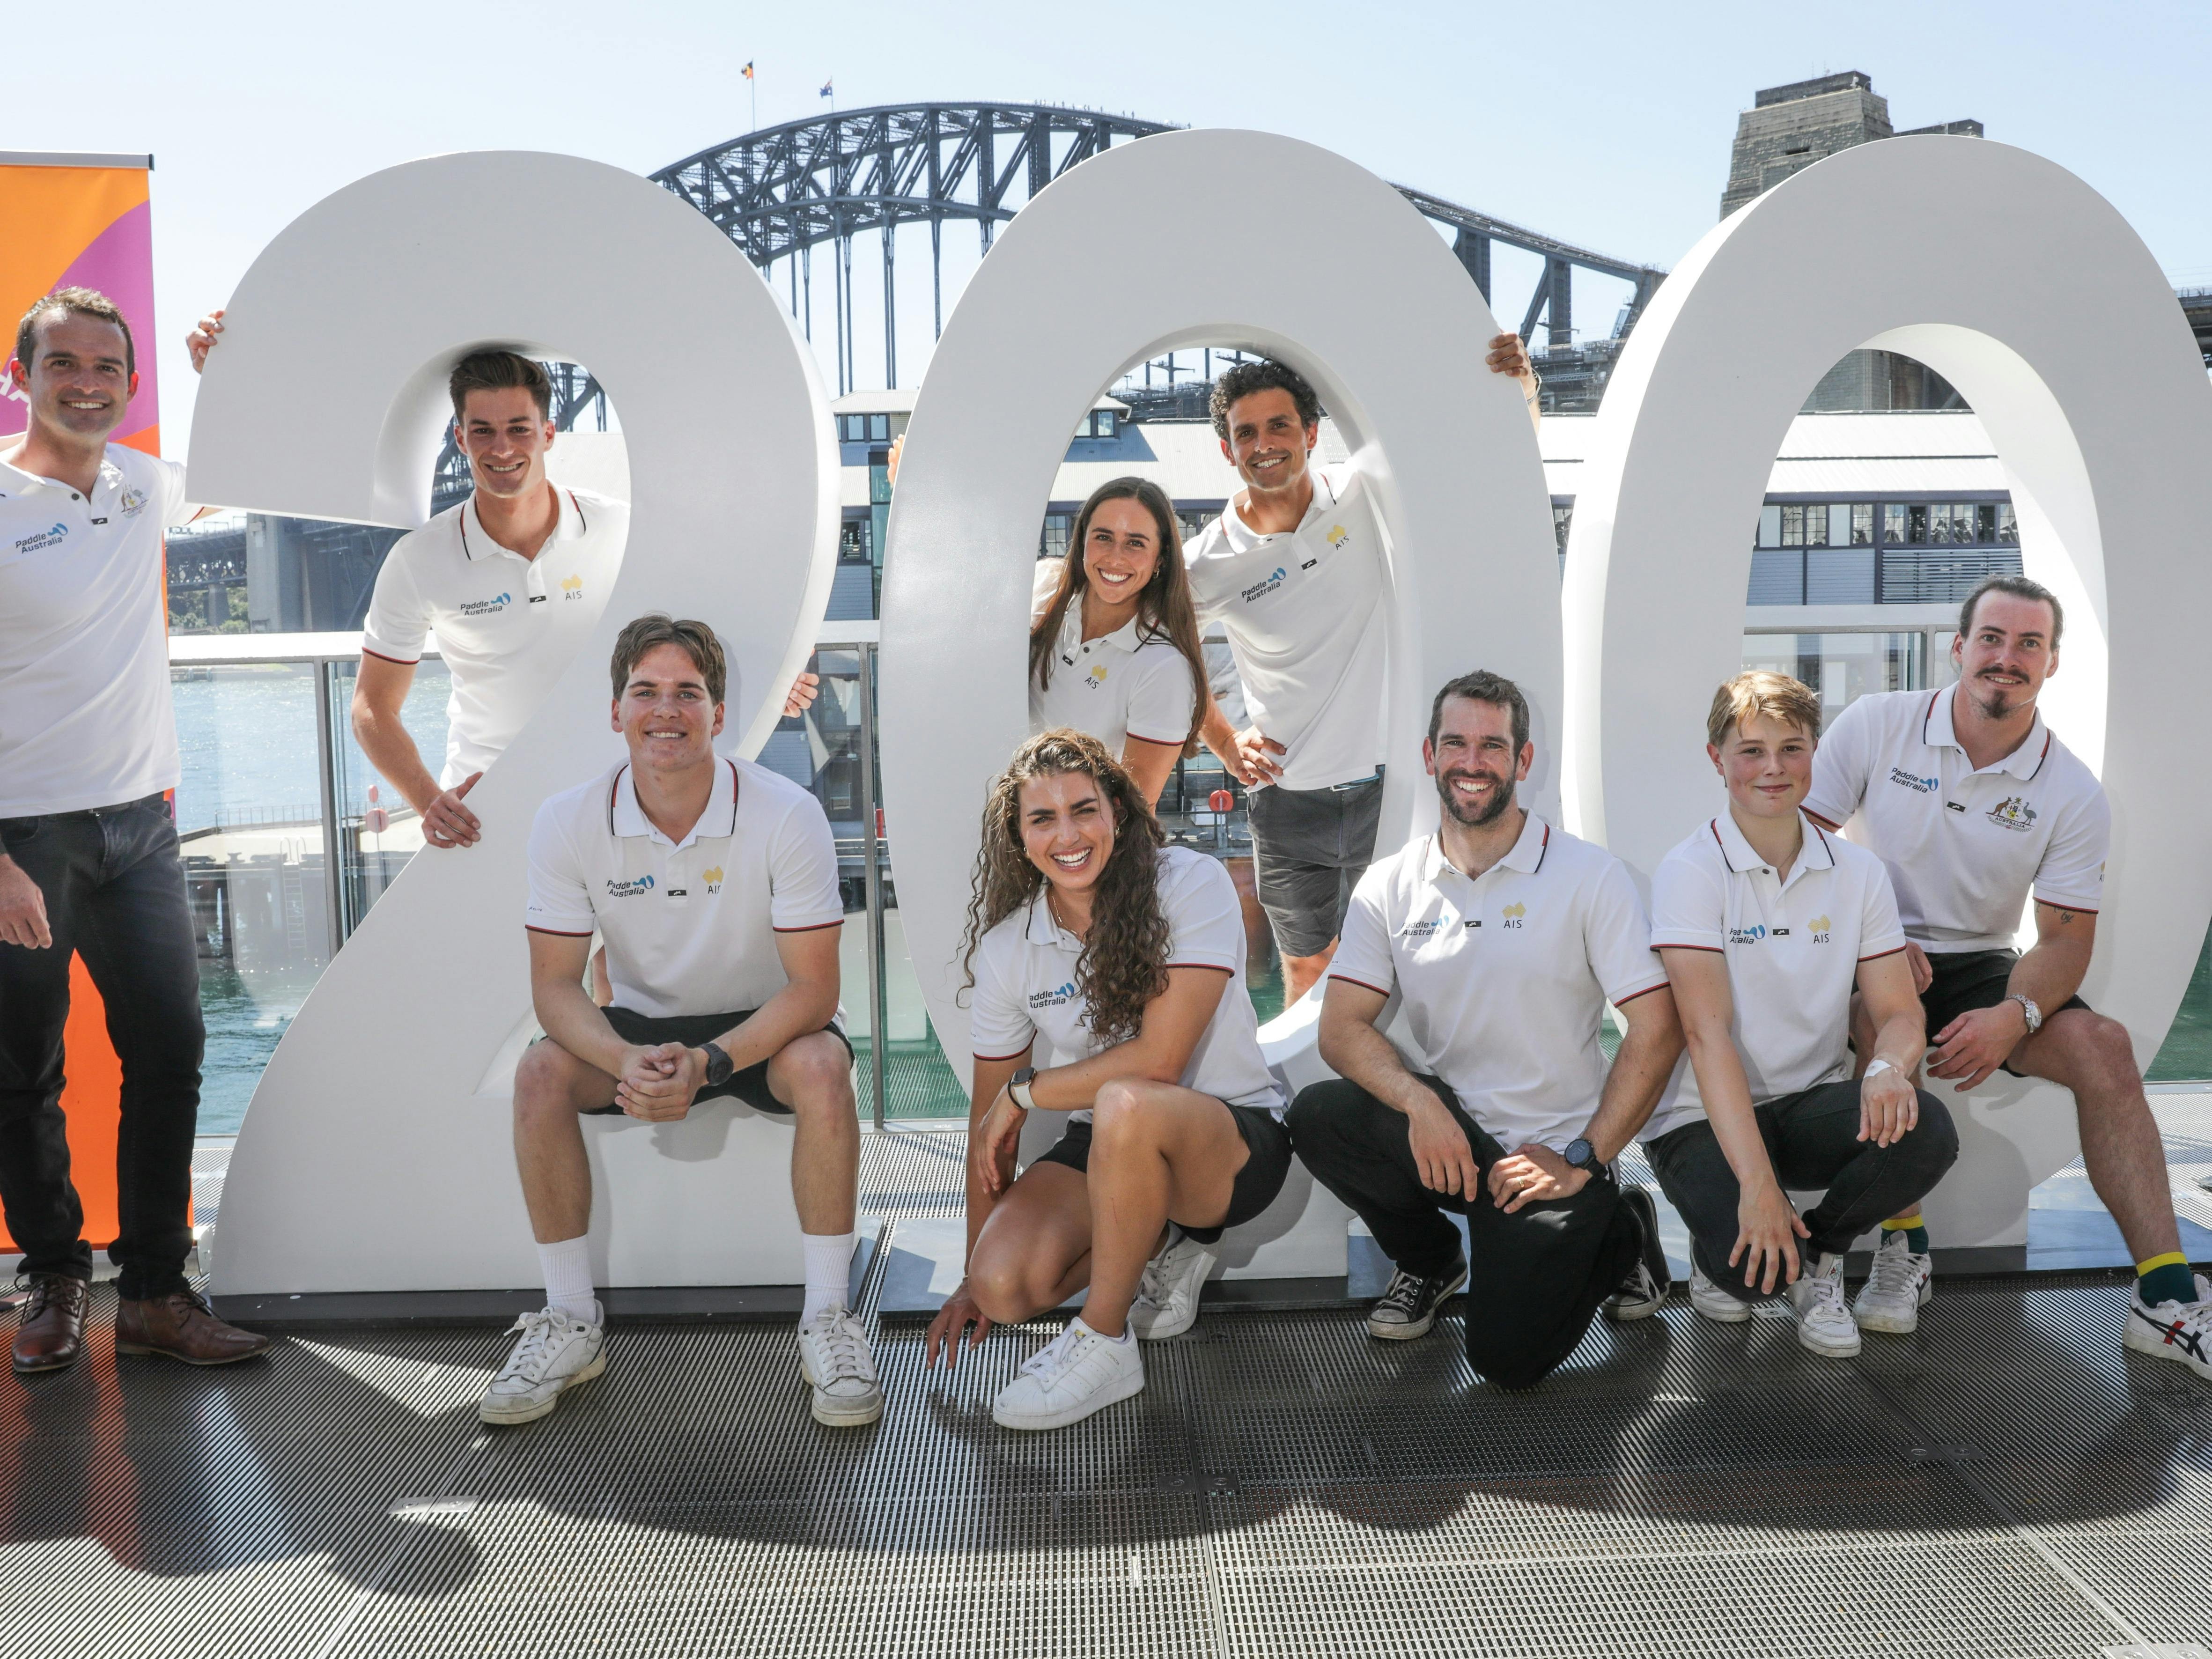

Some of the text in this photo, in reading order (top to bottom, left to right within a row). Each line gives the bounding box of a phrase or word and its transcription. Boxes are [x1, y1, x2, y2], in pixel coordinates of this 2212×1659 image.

[15, 533, 46, 548] Paddle
[22, 537, 62, 554] Australia
[1335, 535, 1349, 550] AIS
[566, 590, 582, 600] AIS
[1241, 581, 1267, 598] Paddle
[1246, 582, 1281, 603] Australia
[460, 601, 489, 610] Paddle
[465, 605, 502, 616] Australia
[1084, 677, 1099, 689] AIS
[1891, 767, 1918, 782] Paddle
[1889, 775, 1928, 793] Australia
[1995, 817, 2025, 828] AUSTRALIA
[609, 887, 644, 897] Australia
[1504, 920, 1522, 929] AIS
[1814, 933, 1829, 944] AIS
[1029, 991, 1053, 1001] addle
